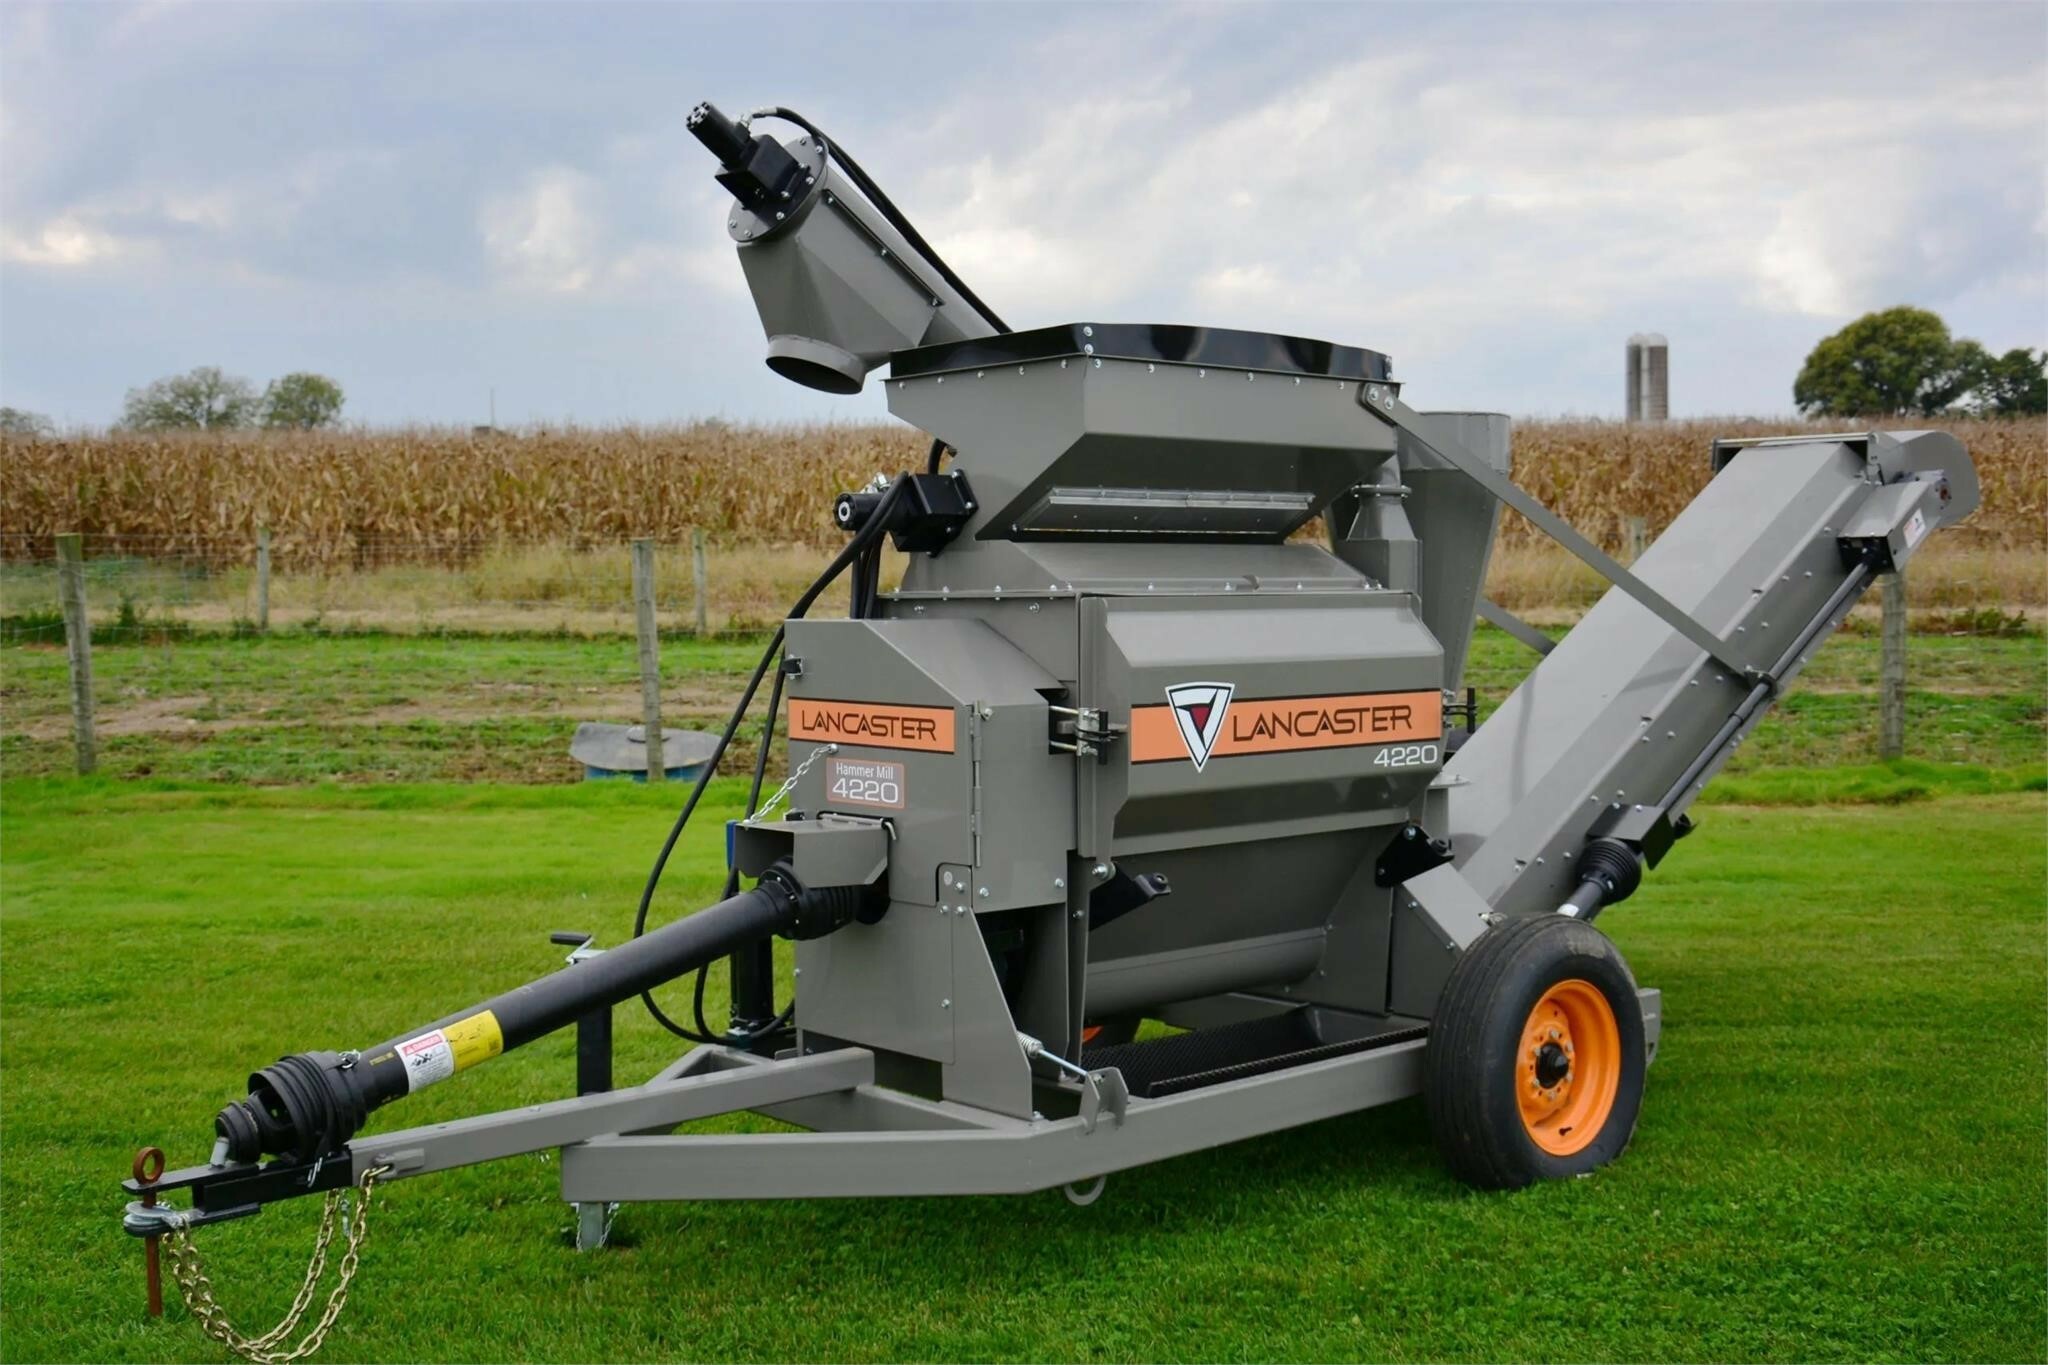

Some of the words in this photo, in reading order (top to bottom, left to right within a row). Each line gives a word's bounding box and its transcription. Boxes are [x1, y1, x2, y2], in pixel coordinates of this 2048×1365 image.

[801, 710, 937, 741] LANCASTER
[1233, 705, 1412, 742] LANCASTER
[1373, 745, 1438, 767] 4220
[836, 762, 874, 777] Hammer
[876, 765, 894, 780] Mill
[832, 778, 899, 803] 4220
